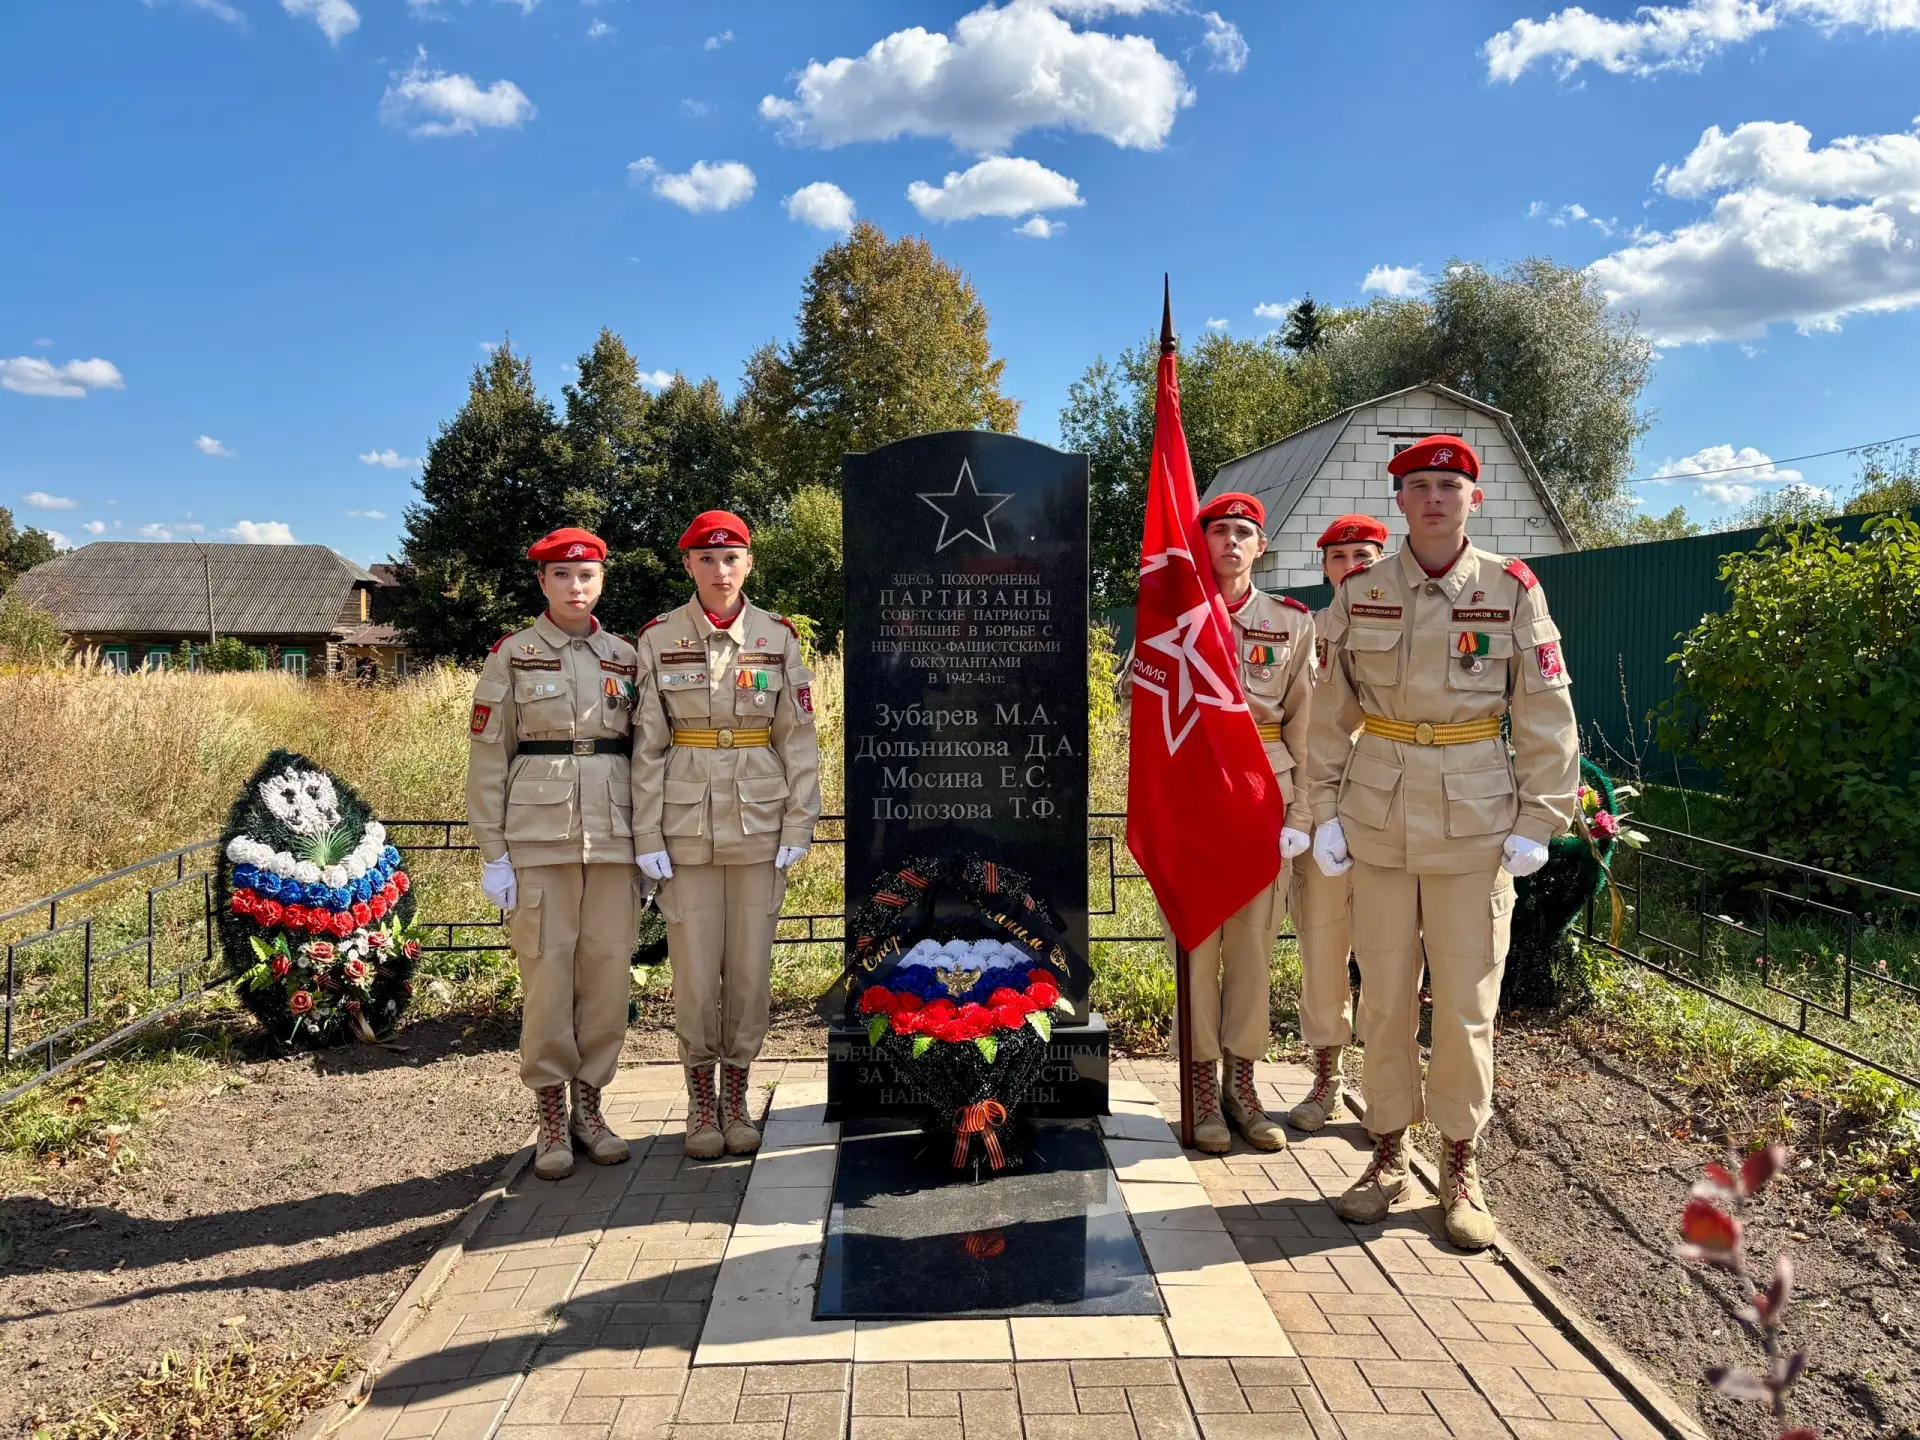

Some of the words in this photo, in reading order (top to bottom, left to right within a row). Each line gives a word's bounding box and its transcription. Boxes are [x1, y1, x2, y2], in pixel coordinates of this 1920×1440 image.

[891, 573, 934, 586] ЗДЕСЬ
[941, 573, 1041, 585] ПОХОРОНЕНЫ
[879, 589, 1053, 606] ПАРТИЗАНЫ
[881, 609, 966, 621] СОВЕТСКИЕ
[973, 609, 1050, 621] ПАТРИОТЫ
[879, 625, 961, 637] ПОГИБШИЕ
[968, 625, 978, 636] В
[985, 625, 1036, 636] БОРЬБЕ
[1043, 625, 1053, 636] С
[871, 640, 1061, 654] НЕМЕЦКО-ФАШИСТСКИМИ
[910, 656, 1021, 668] ОККУПАНТАМИ
[928, 672, 937, 684] В
[945, 672, 1005, 684] 1942-43гг.
[875, 703, 978, 732] Зубарев
[994, 703, 1058, 726] М.А.
[854, 734, 1010, 763] Дольникова
[1024, 734, 1082, 762] Д.А.
[881, 766, 984, 789] Мосина
[999, 765, 1052, 788] Е.С.
[871, 797, 993, 820] Полозова
[1008, 796, 1062, 819] Т.Ф.
[857, 1066, 885, 1083] ЗА
